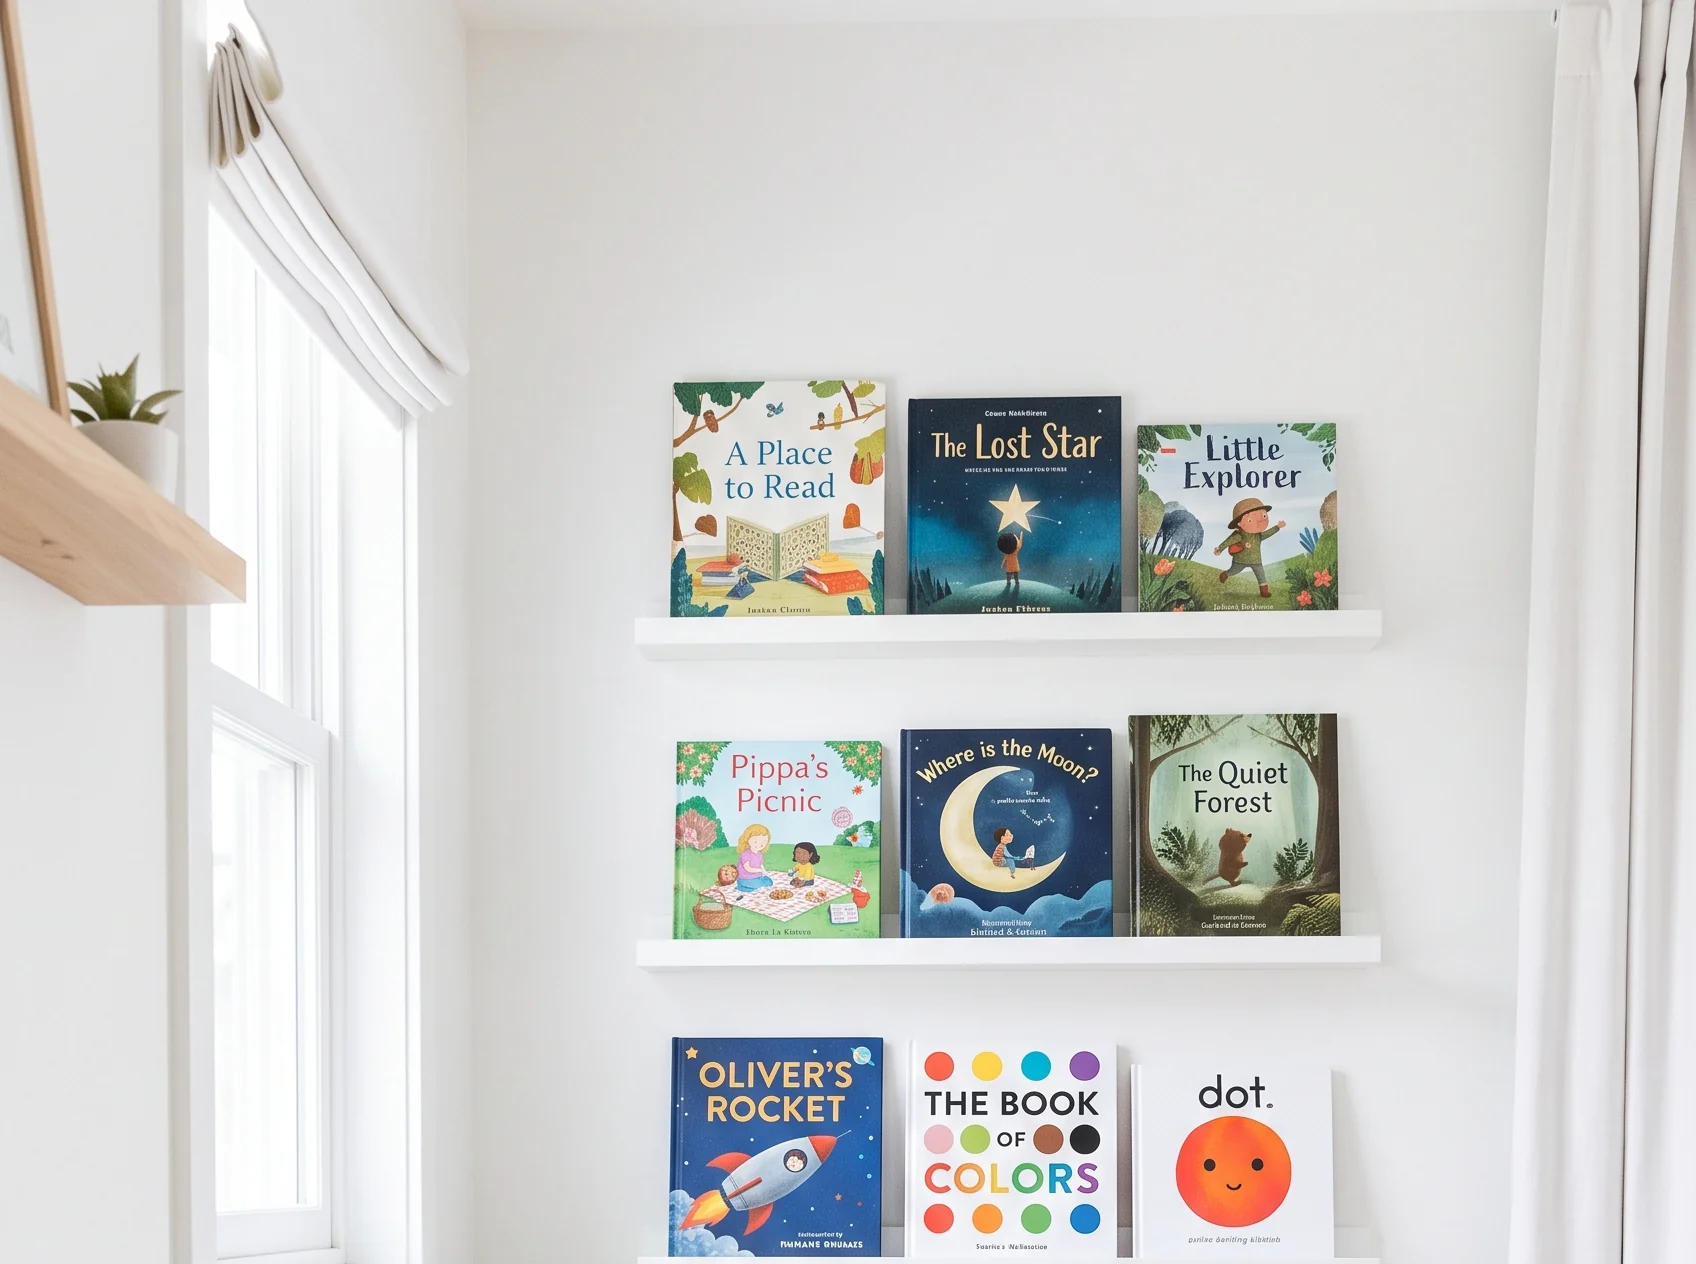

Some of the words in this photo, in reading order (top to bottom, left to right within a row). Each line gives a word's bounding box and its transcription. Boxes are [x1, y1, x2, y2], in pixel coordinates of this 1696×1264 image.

[725, 441, 748, 466] A
[757, 440, 832, 466] Place
[931, 432, 967, 458] The
[976, 423, 1032, 459] Lost
[1042, 422, 1102, 459] Star
[1207, 434, 1285, 461] Little
[725, 477, 754, 499] to
[764, 473, 836, 499] Read
[1183, 461, 1302, 497] Explorer
[731, 753, 829, 786] Pippa's
[916, 748, 975, 784] Where
[979, 741, 996, 758] is
[1001, 738, 1033, 758] the
[1037, 743, 1099, 784] Moon?
[1178, 764, 1212, 782] The
[1218, 760, 1289, 789] Quiet
[737, 787, 822, 812] Picnic
[1194, 790, 1272, 813] Forest
[699, 1061, 853, 1088] OLIVER'S
[707, 1095, 846, 1122] ROCKET
[924, 1091, 988, 1116] THE
[1001, 1091, 1099, 1116] BOOK
[997, 1132, 1026, 1147] OF
[924, 1162, 1099, 1194] COLORS
